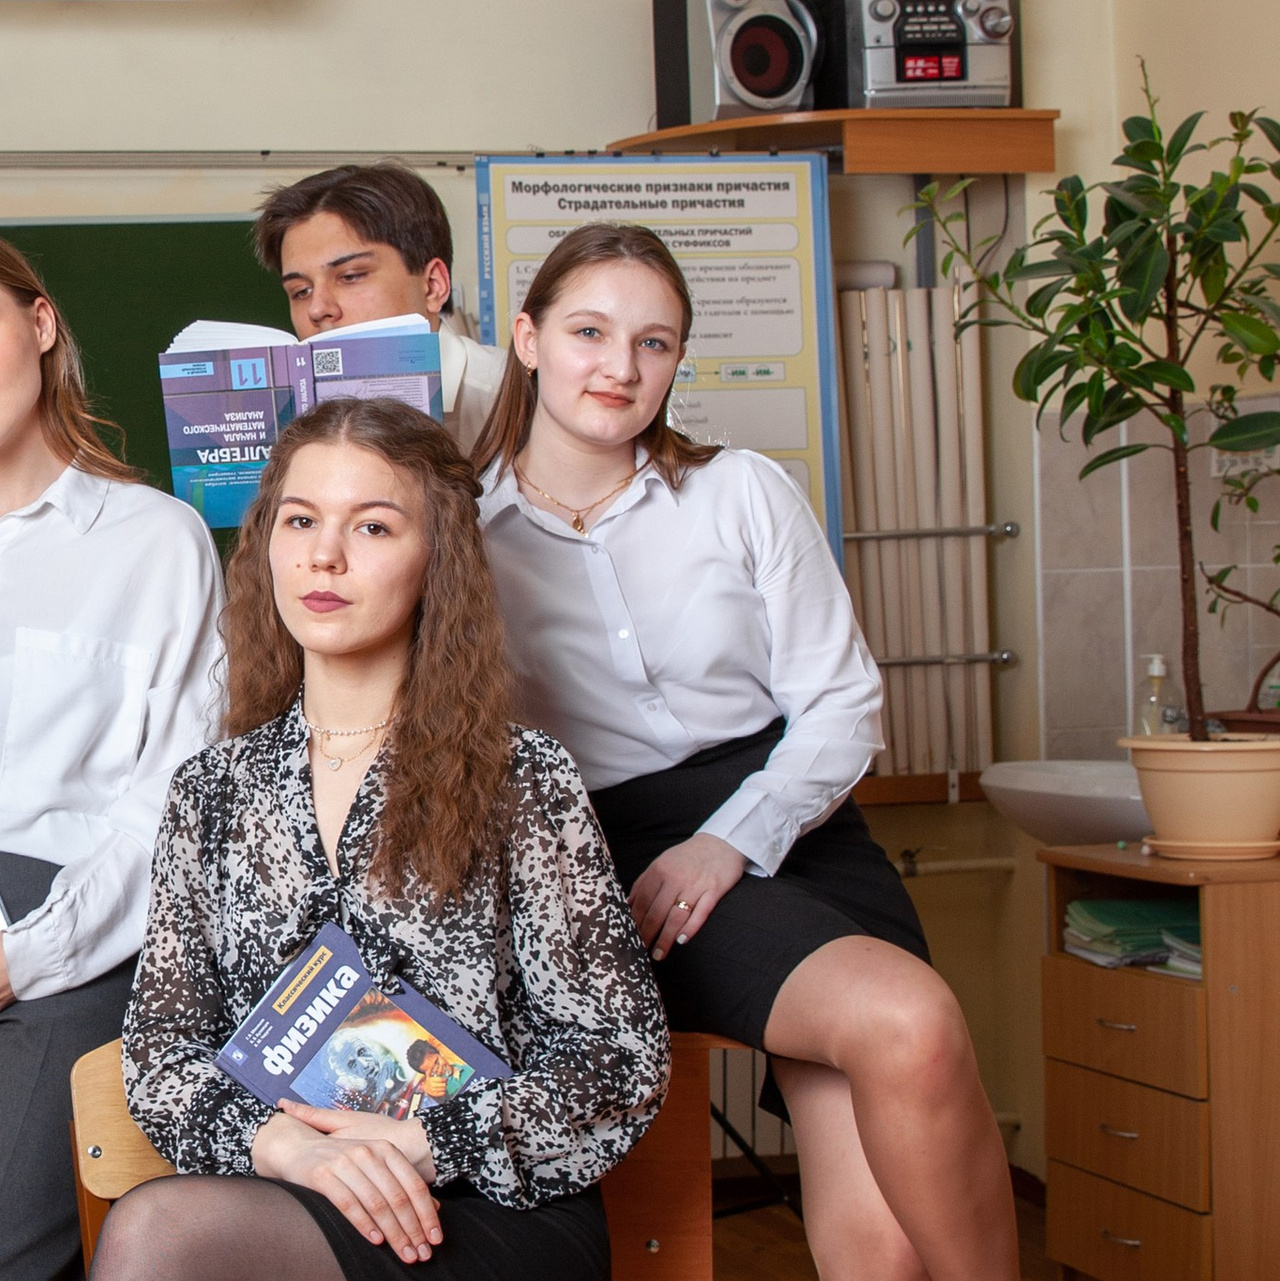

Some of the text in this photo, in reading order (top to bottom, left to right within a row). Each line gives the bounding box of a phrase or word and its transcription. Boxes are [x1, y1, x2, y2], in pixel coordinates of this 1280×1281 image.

[511, 180, 790, 195] Морфологические признаки причастия
[558, 197, 745, 212] Страдательные причастия
[698, 227, 752, 237] ПРИЧАСТИЙ
[481, 205, 491, 280] РУССКИЙ ЯЗЫК
[671, 239, 732, 249] СУФФИКСОВ
[296, 356, 306, 367] 11
[237, 363, 262, 386] 11
[224, 410, 264, 421] АНАЛИЗА
[183, 421, 265, 435] МАТЕМАТИЧЕСКОГО
[224, 431, 266, 442] И НАЧАЛА
[197, 445, 272, 463] АЛГЕБРА
[277, 951, 328, 1010] Классический курс
[262, 965, 361, 1076] физика
